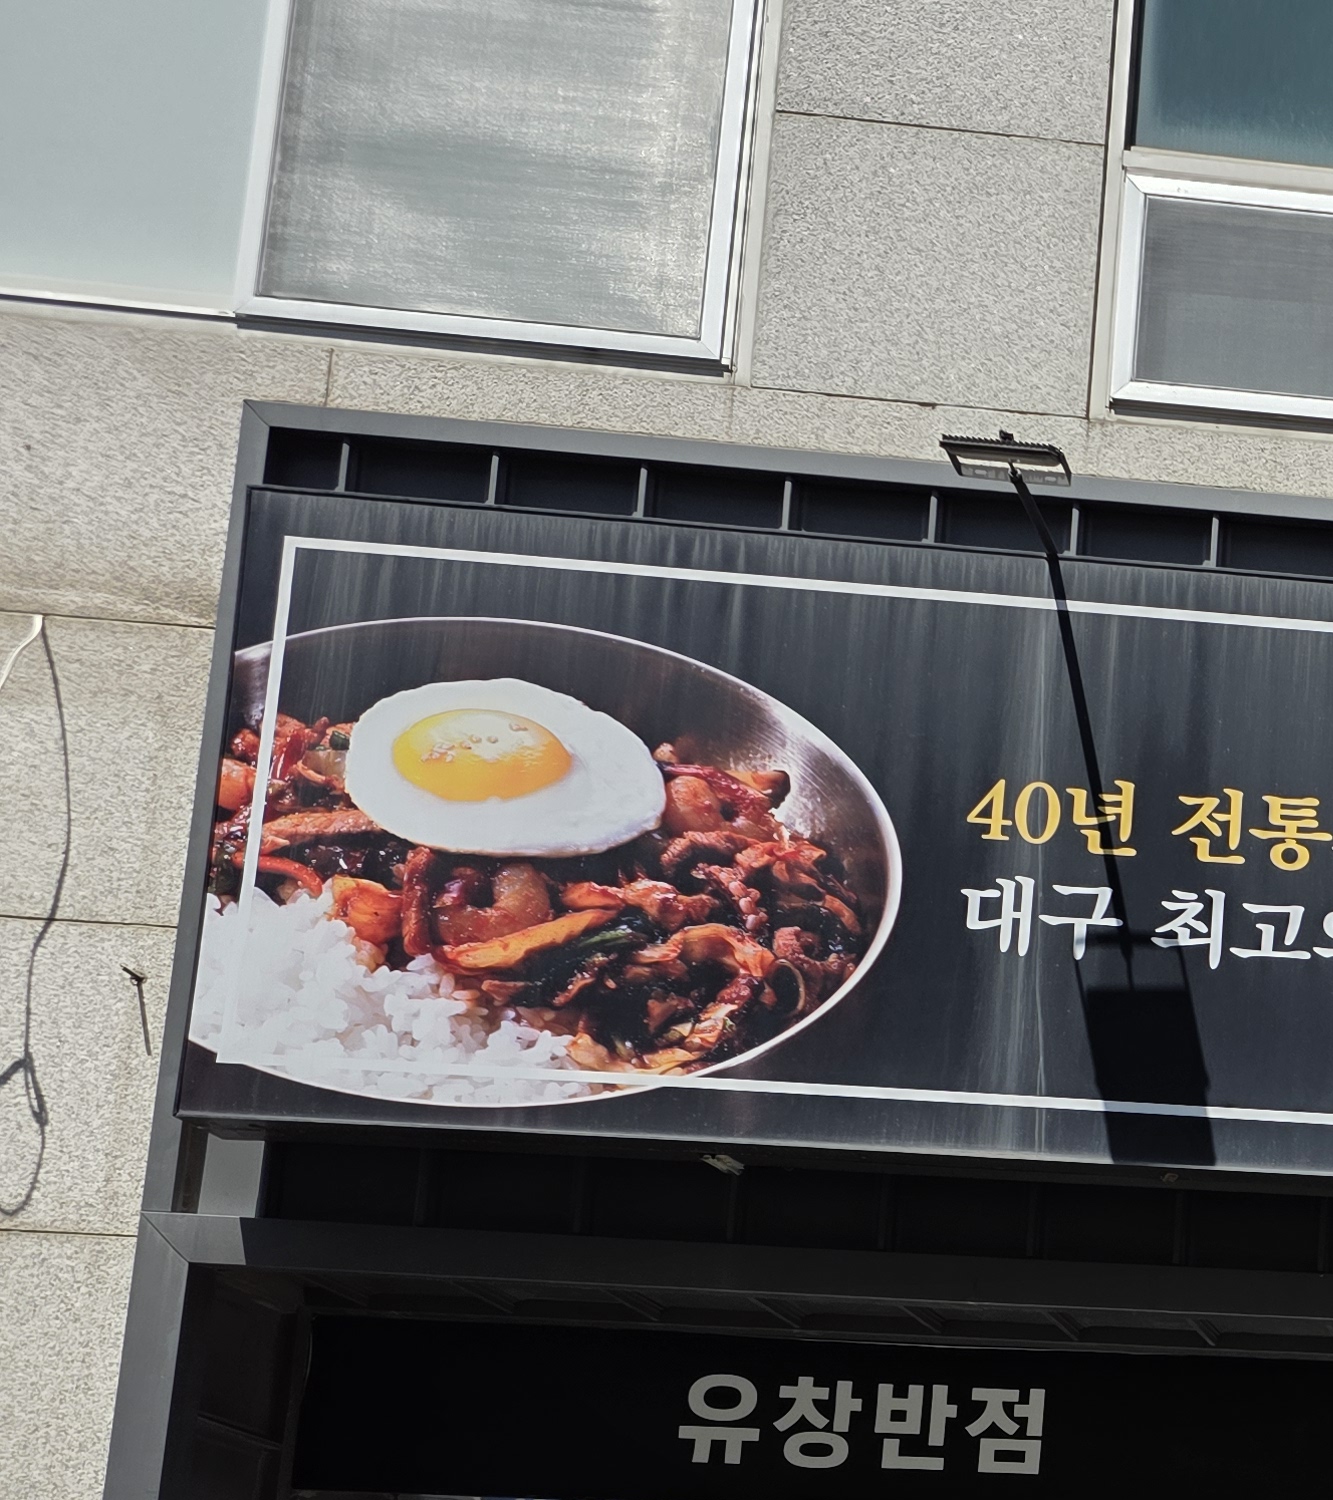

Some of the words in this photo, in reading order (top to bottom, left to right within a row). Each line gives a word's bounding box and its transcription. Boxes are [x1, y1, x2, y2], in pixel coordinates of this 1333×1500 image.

[967, 778, 1138, 857] 40년
[960, 876, 1123, 960] 대구
[678, 1372, 1046, 1476] 유창반점
